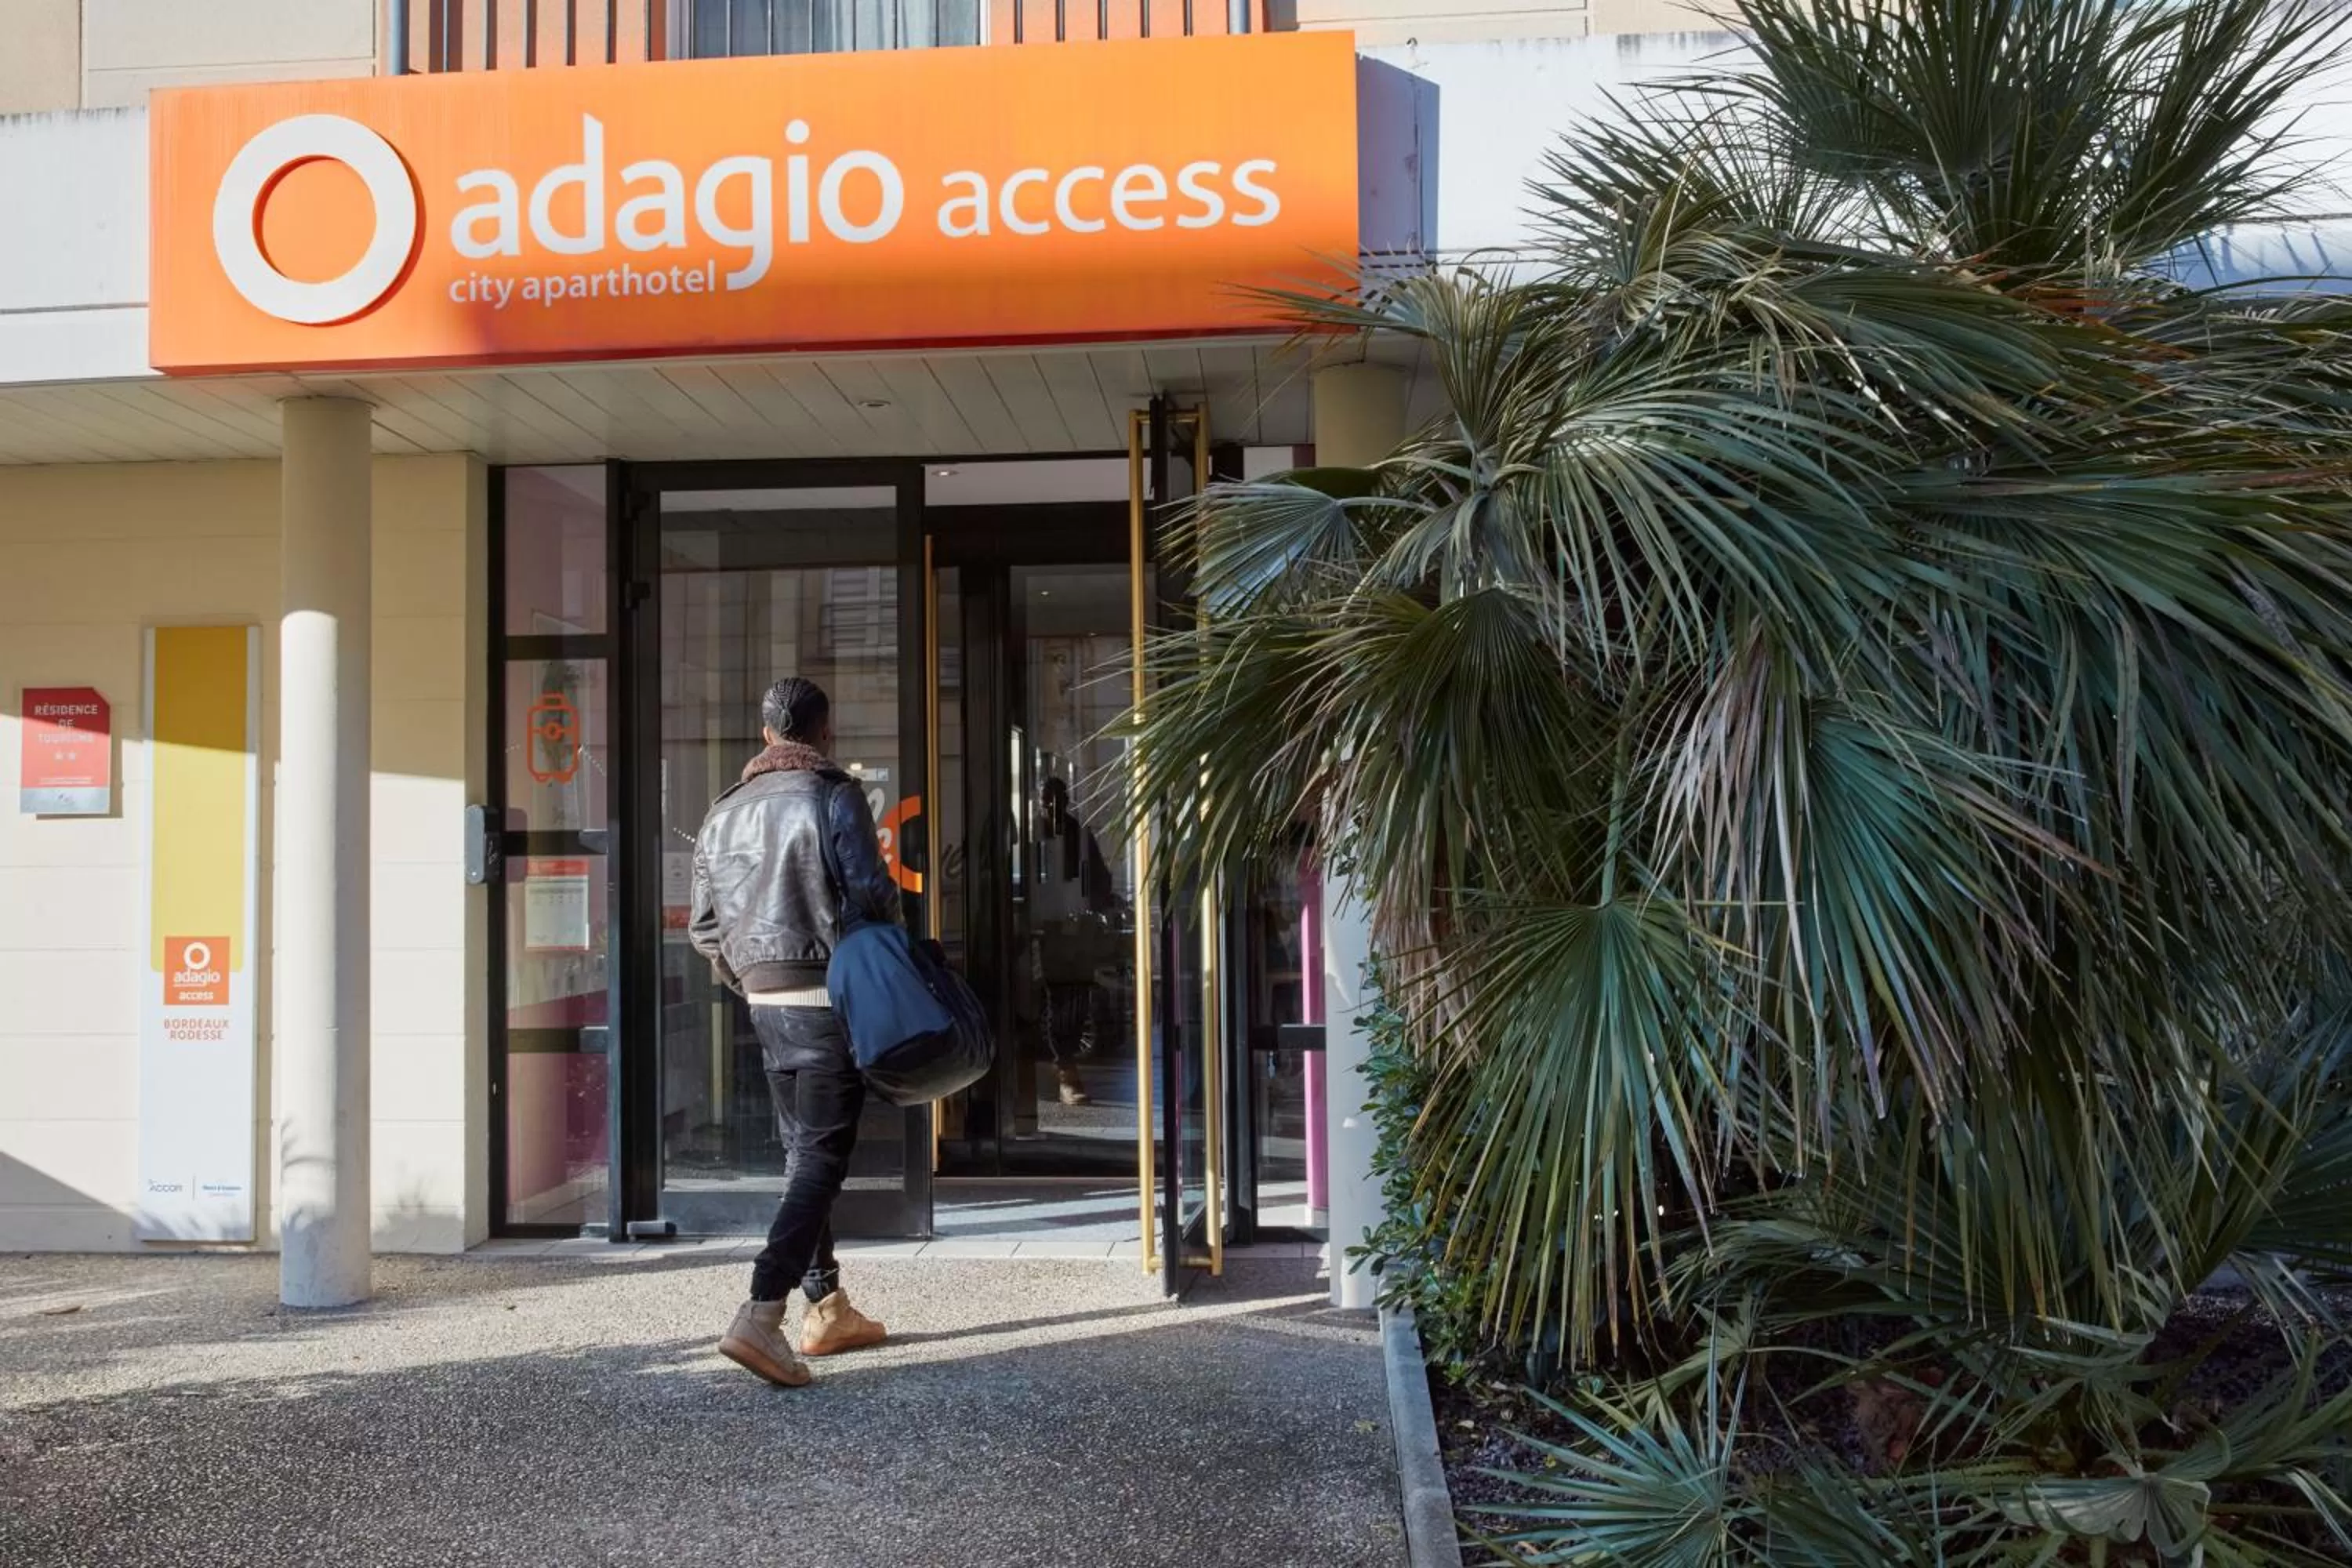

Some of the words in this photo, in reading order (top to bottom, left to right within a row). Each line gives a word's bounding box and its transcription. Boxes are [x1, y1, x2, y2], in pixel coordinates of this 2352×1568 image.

[451, 113, 904, 290] adagio
[938, 159, 1280, 237] access
[448, 270, 514, 310] city
[521, 259, 715, 308] aparthotel
[34, 702, 99, 715] RÉSIDENCE
[173, 968, 221, 987] adagio
[164, 1018, 230, 1029] BORDEAUX
[169, 1030, 224, 1040] RODESSE
